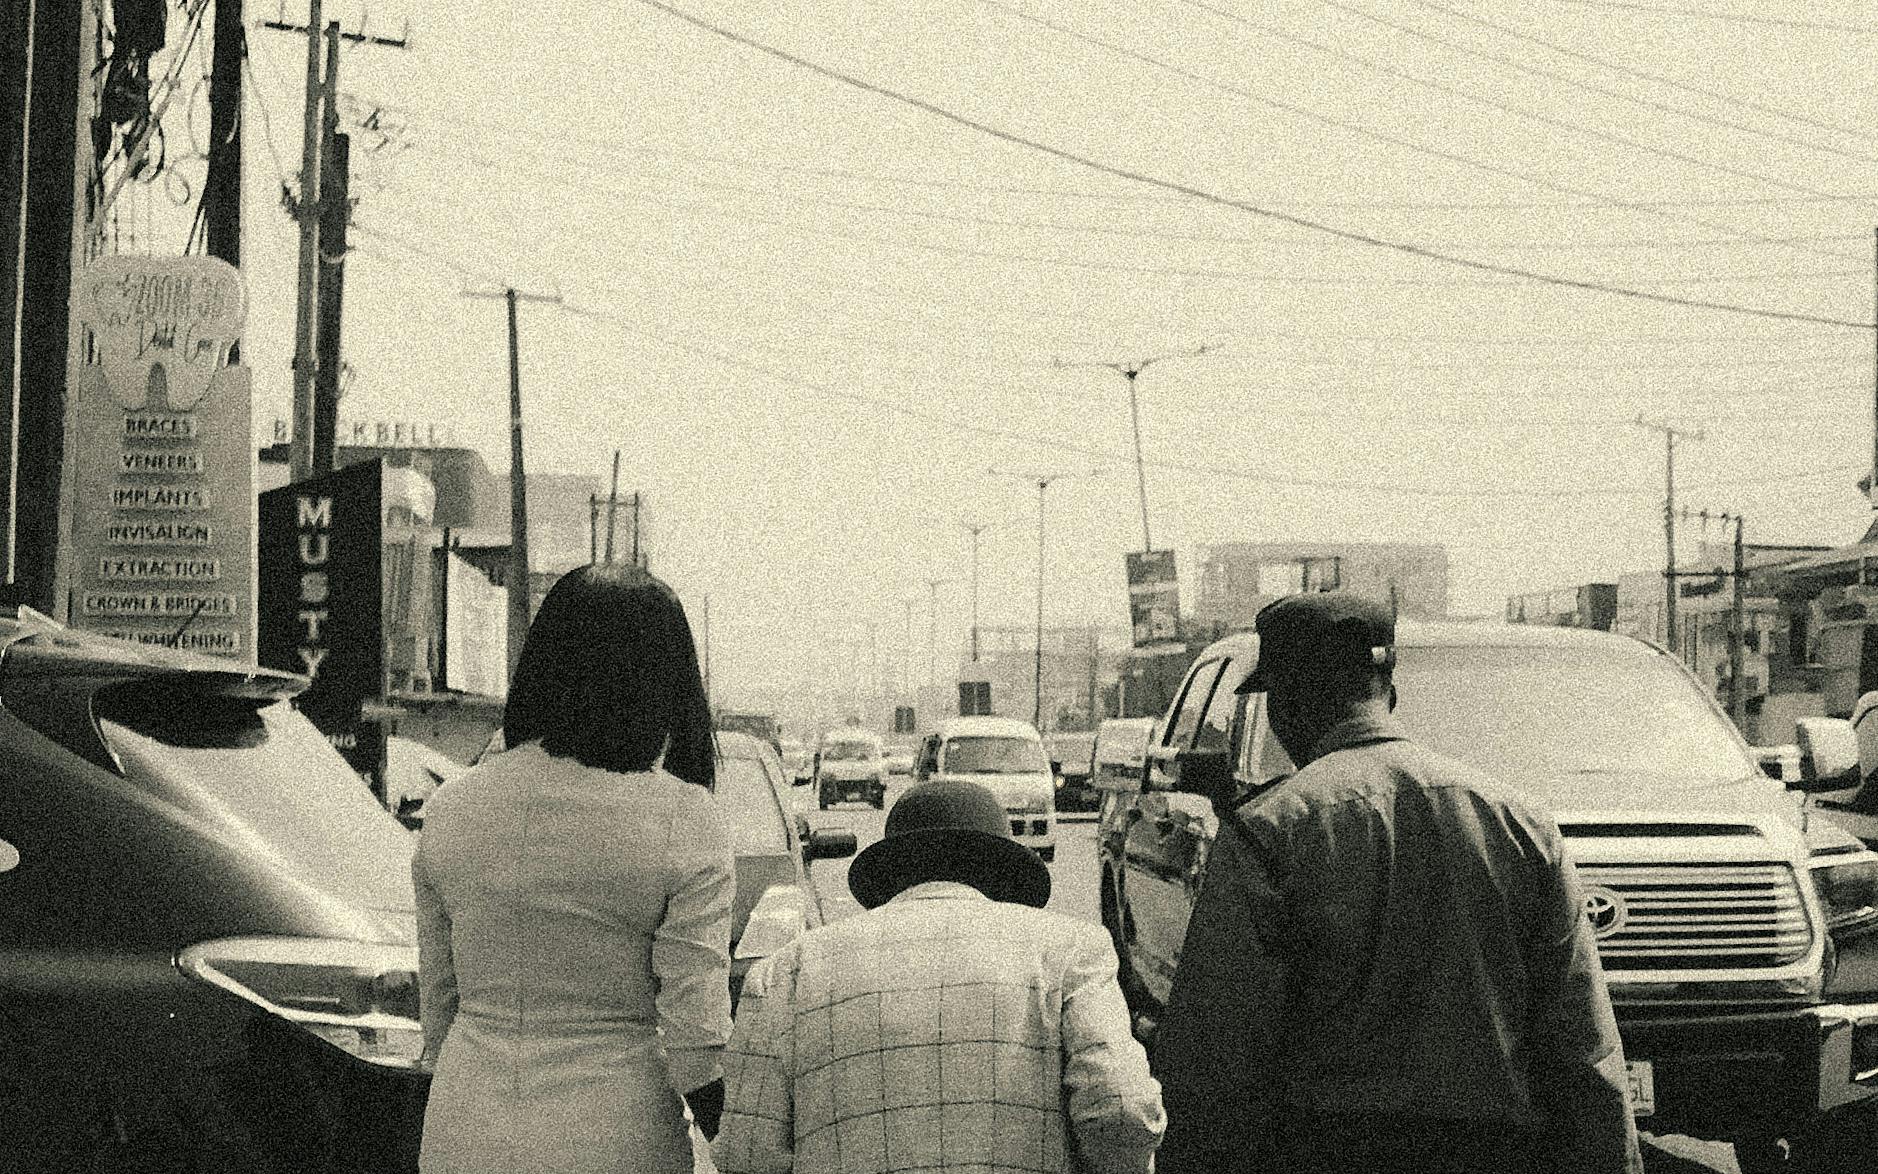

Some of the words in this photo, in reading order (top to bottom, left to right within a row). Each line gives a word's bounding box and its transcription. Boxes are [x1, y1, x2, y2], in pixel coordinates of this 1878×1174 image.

[125, 418, 191, 433] BRACES
[122, 455, 198, 469] VENEERS
[112, 489, 203, 505] IMPLANTS
[108, 525, 209, 541] INVISALIGN
[103, 560, 215, 577] EXTRACTION
[296, 497, 333, 679] MUSTY
[86, 596, 147, 611] CROWN
[151, 597, 160, 611] &
[165, 597, 231, 614] BRIDGES
